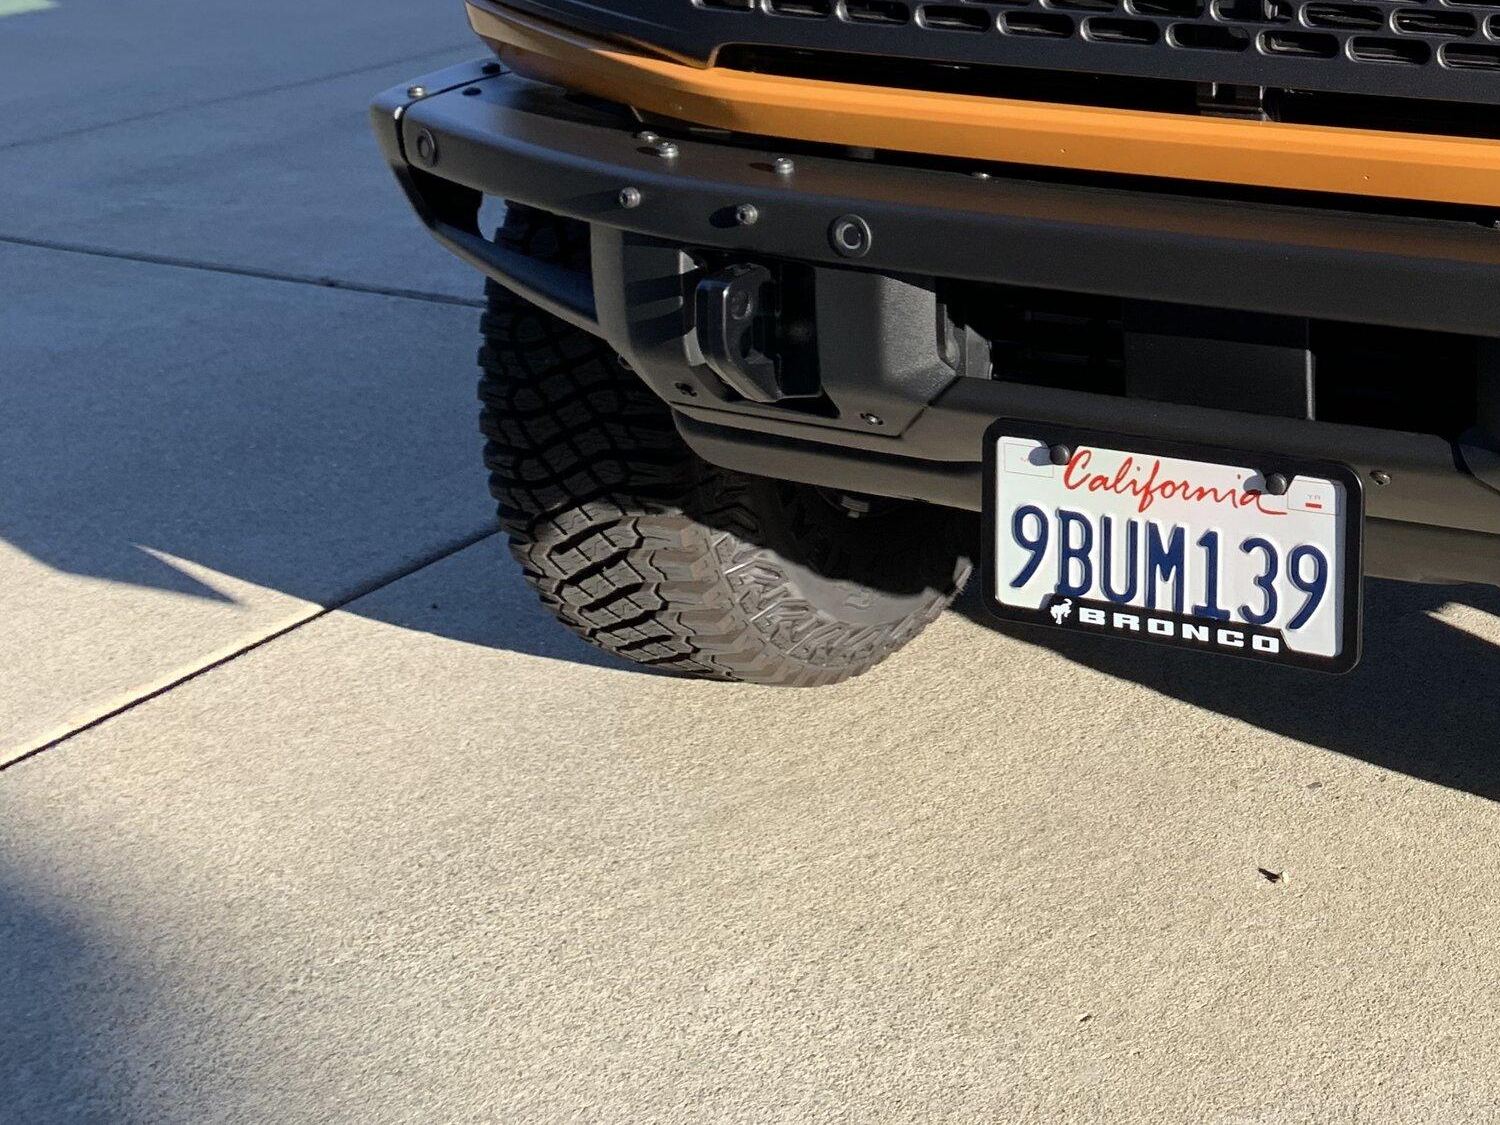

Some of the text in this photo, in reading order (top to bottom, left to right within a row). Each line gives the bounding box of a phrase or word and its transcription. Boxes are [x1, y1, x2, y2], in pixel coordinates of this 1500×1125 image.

[1062, 448, 1288, 517] California
[1010, 504, 1329, 631] 9BUM139
[1078, 606, 1280, 654] BRONCO
